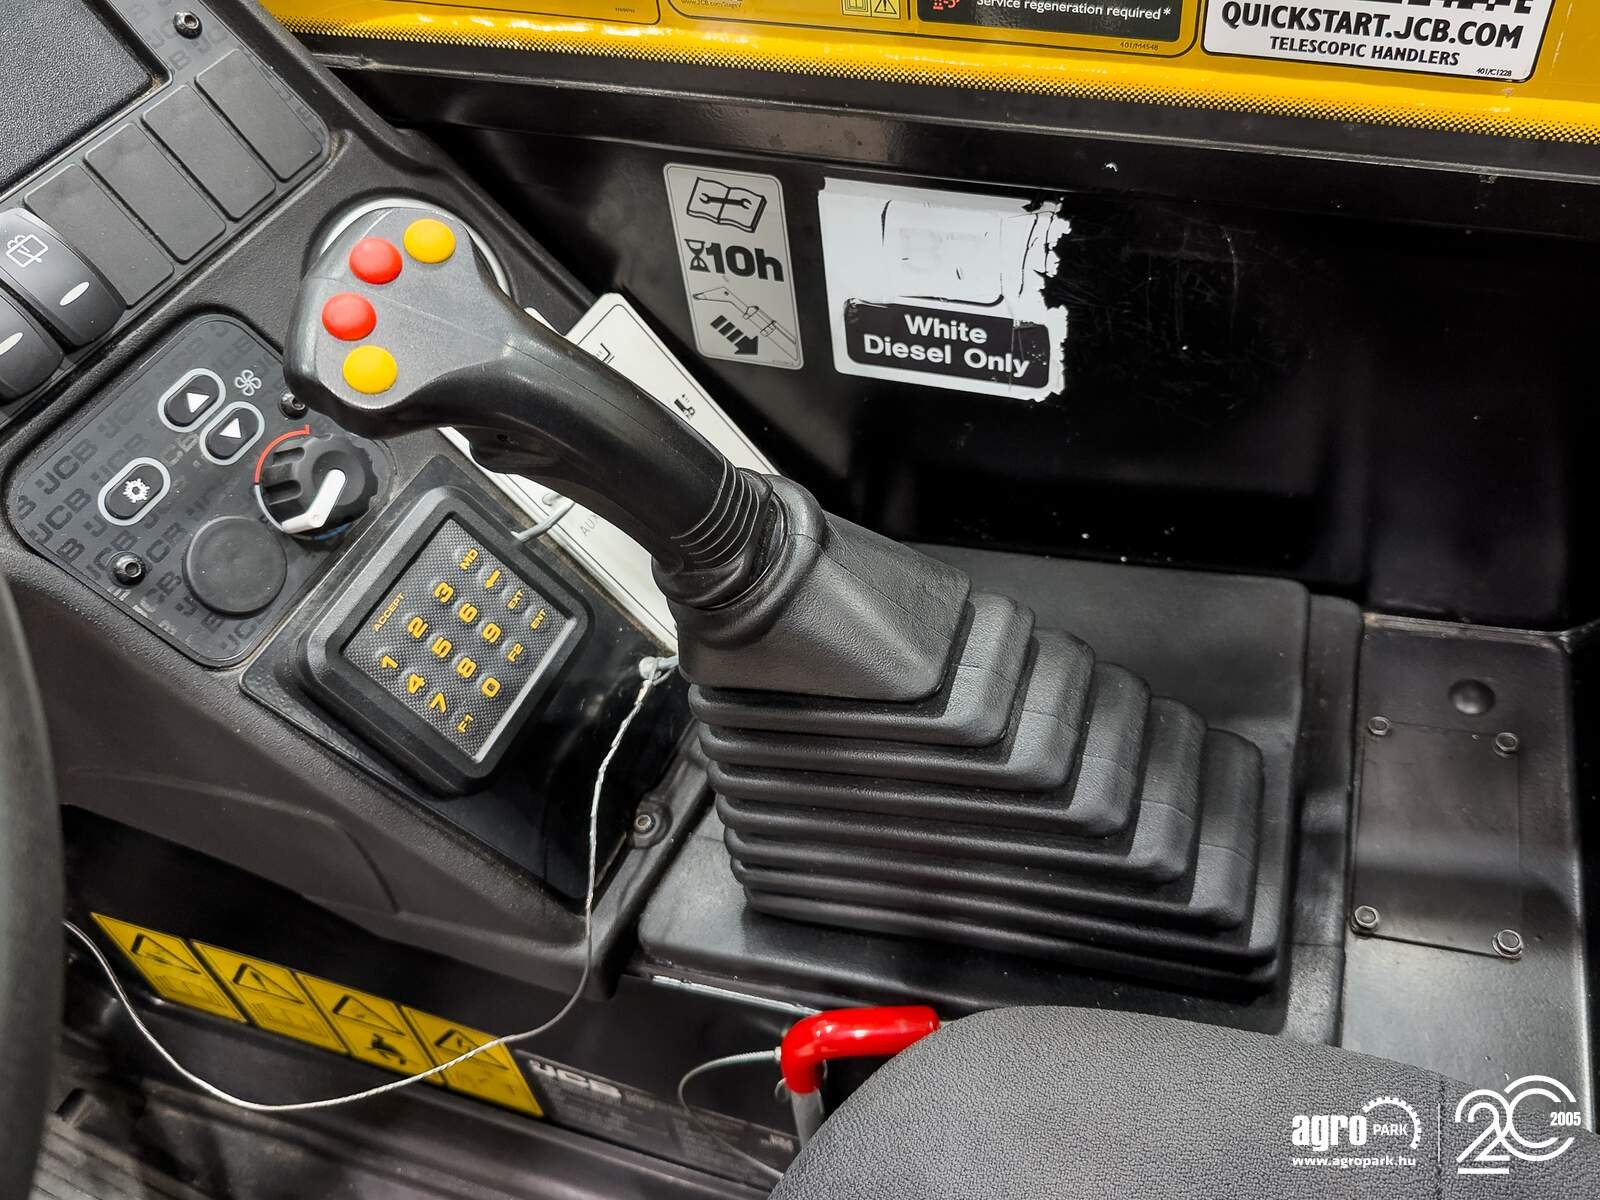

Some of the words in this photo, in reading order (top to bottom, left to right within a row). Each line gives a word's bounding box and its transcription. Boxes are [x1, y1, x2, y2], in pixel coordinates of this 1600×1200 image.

[1024, 2, 1104, 16] regeneration
[1221, 1, 1524, 49] QUICKSTART.JCB.COM
[1270, 36, 1367, 58] TELESCOPIC
[1370, 46, 1461, 66] HANDLERS
[705, 242, 785, 282] 10h
[904, 314, 988, 344] White
[863, 333, 951, 365] Diesel
[963, 348, 1030, 378] Only
[35, 438, 98, 495] JCB
[26, 487, 92, 545] JCB
[459, 548, 479, 570] MD
[434, 582, 455, 603] 3
[507, 588, 524, 610] EXT
[373, 592, 405, 632] ACCEPT
[458, 603, 479, 624] 6
[530, 608, 548, 630] ENT
[407, 616, 429, 639] 2
[482, 622, 503, 643] 9
[431, 637, 453, 659] 5
[507, 643, 525, 663] F2
[380, 655, 399, 671] 1
[456, 657, 478, 679] 8
[406, 673, 426, 694] 4
[481, 676, 501, 698] 0
[429, 692, 447, 713] 7
[456, 713, 474, 733] F1
